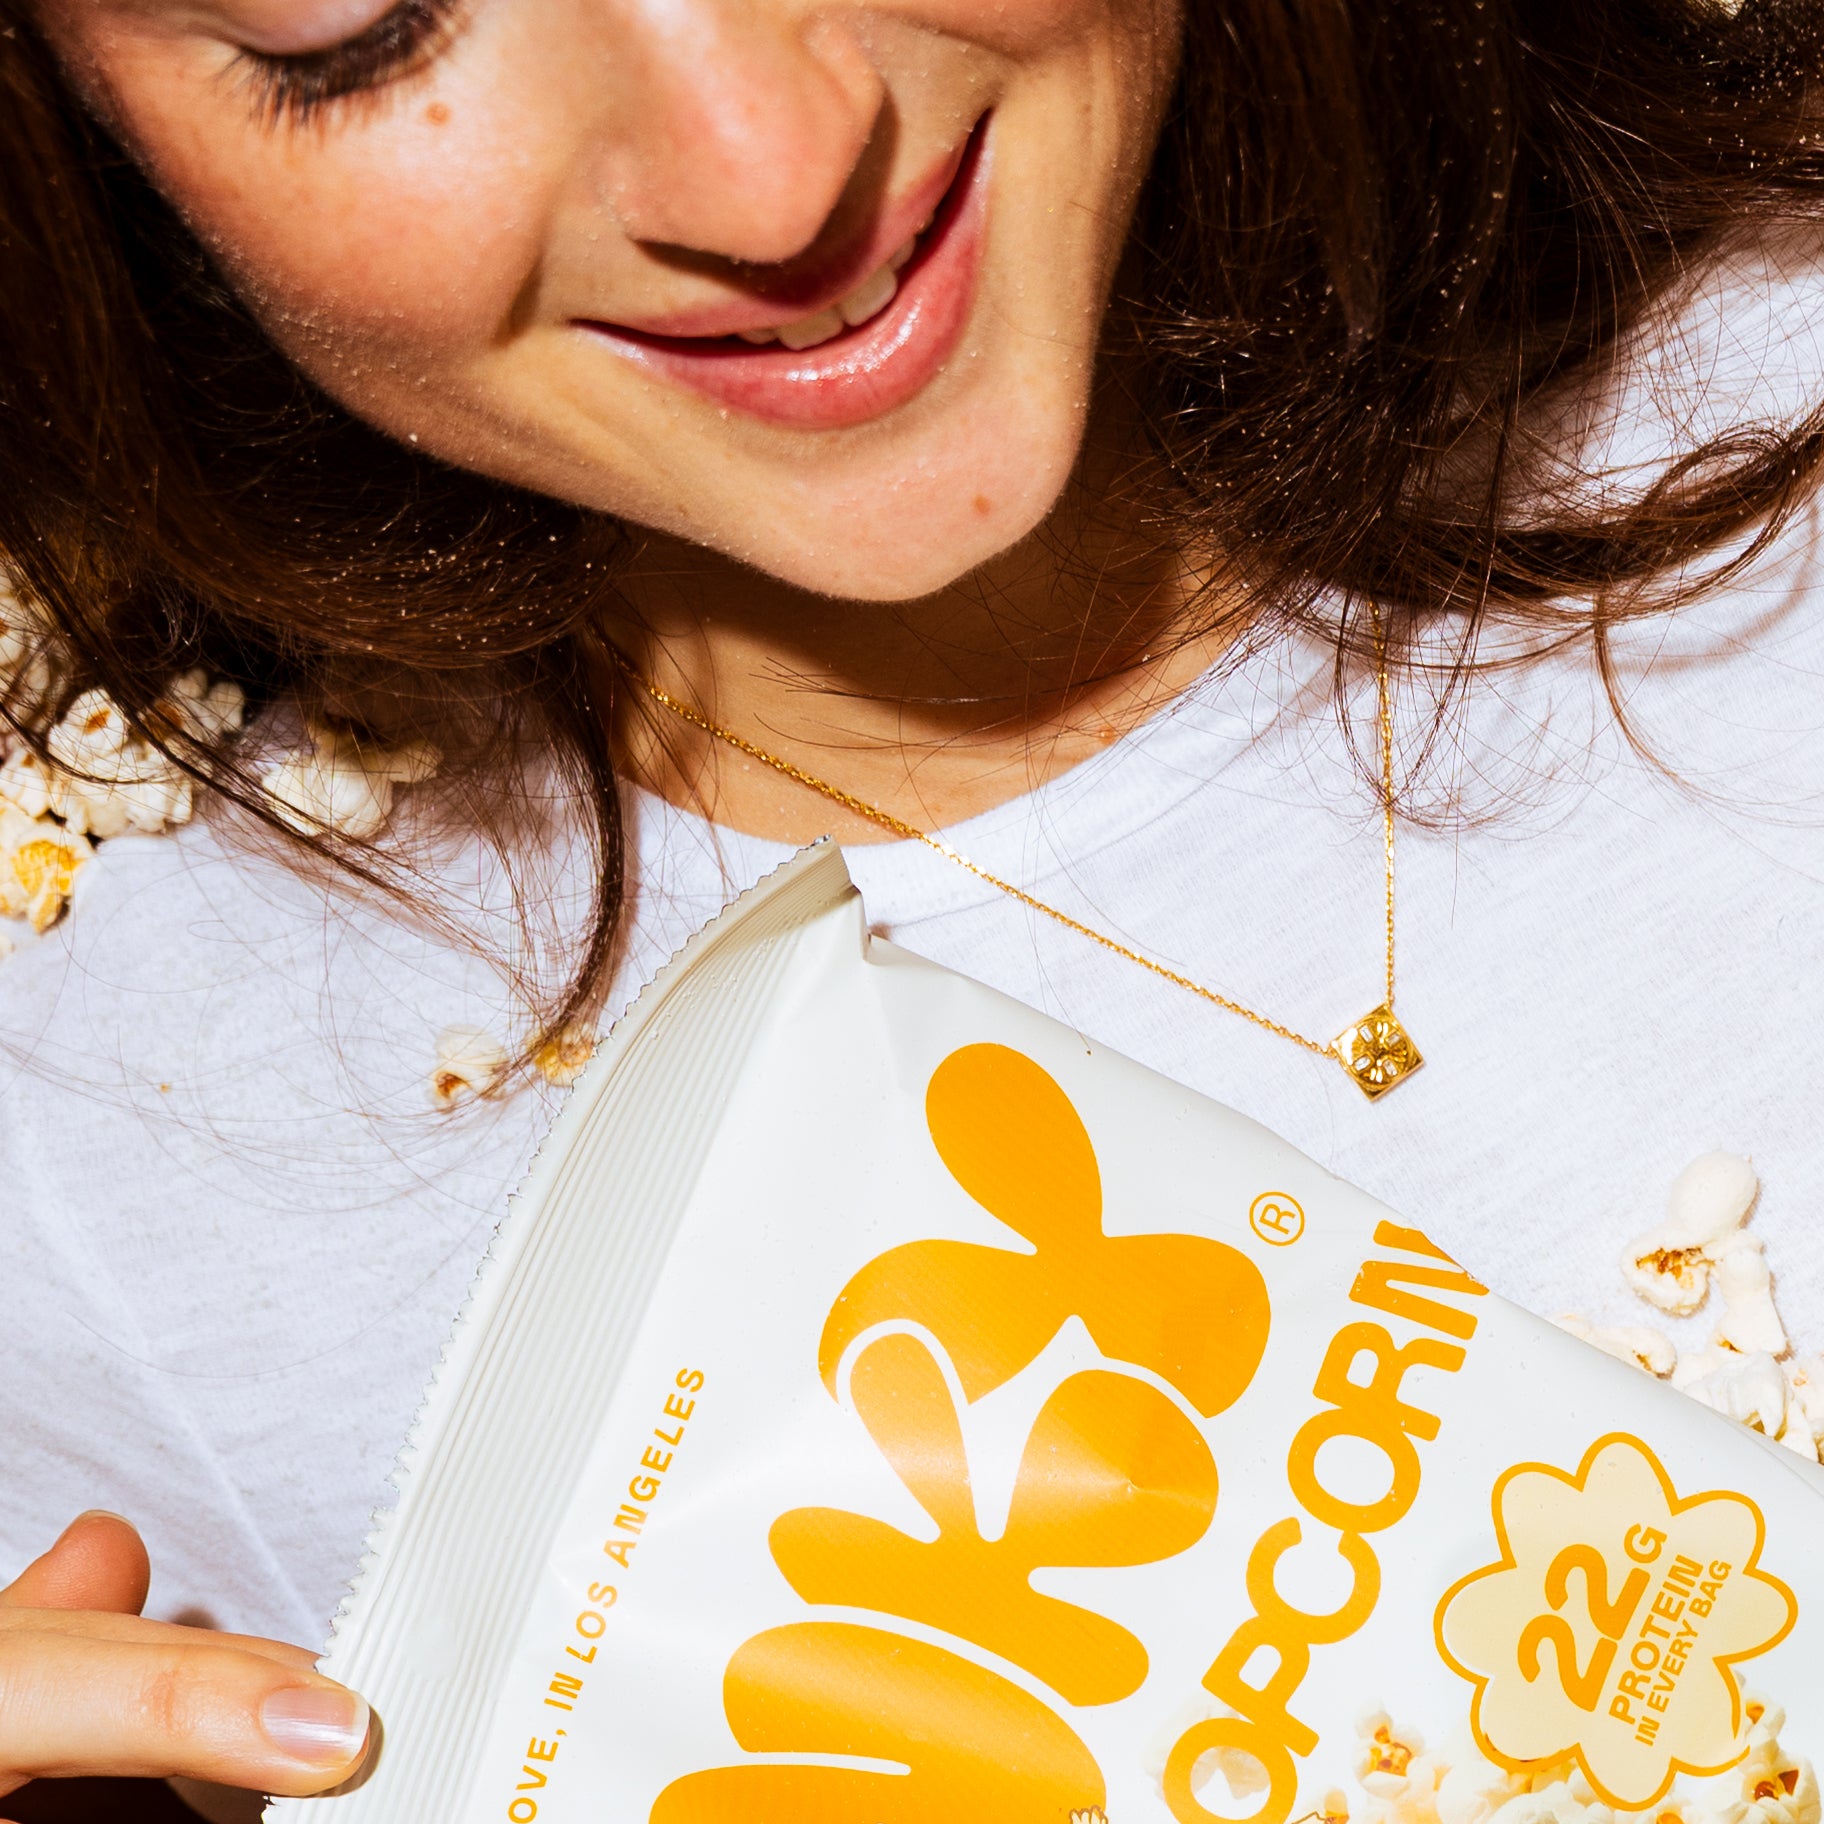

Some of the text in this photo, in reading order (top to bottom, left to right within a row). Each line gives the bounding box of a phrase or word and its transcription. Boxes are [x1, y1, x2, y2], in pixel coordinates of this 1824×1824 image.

[543, 1671, 584, 1712] IN
[565, 1582, 618, 1665] LOS
[607, 1367, 705, 1569] ANGELES
[1608, 1554, 1704, 1725] PROTEIN
[1635, 1560, 1732, 1747] IN EVERY BAG
